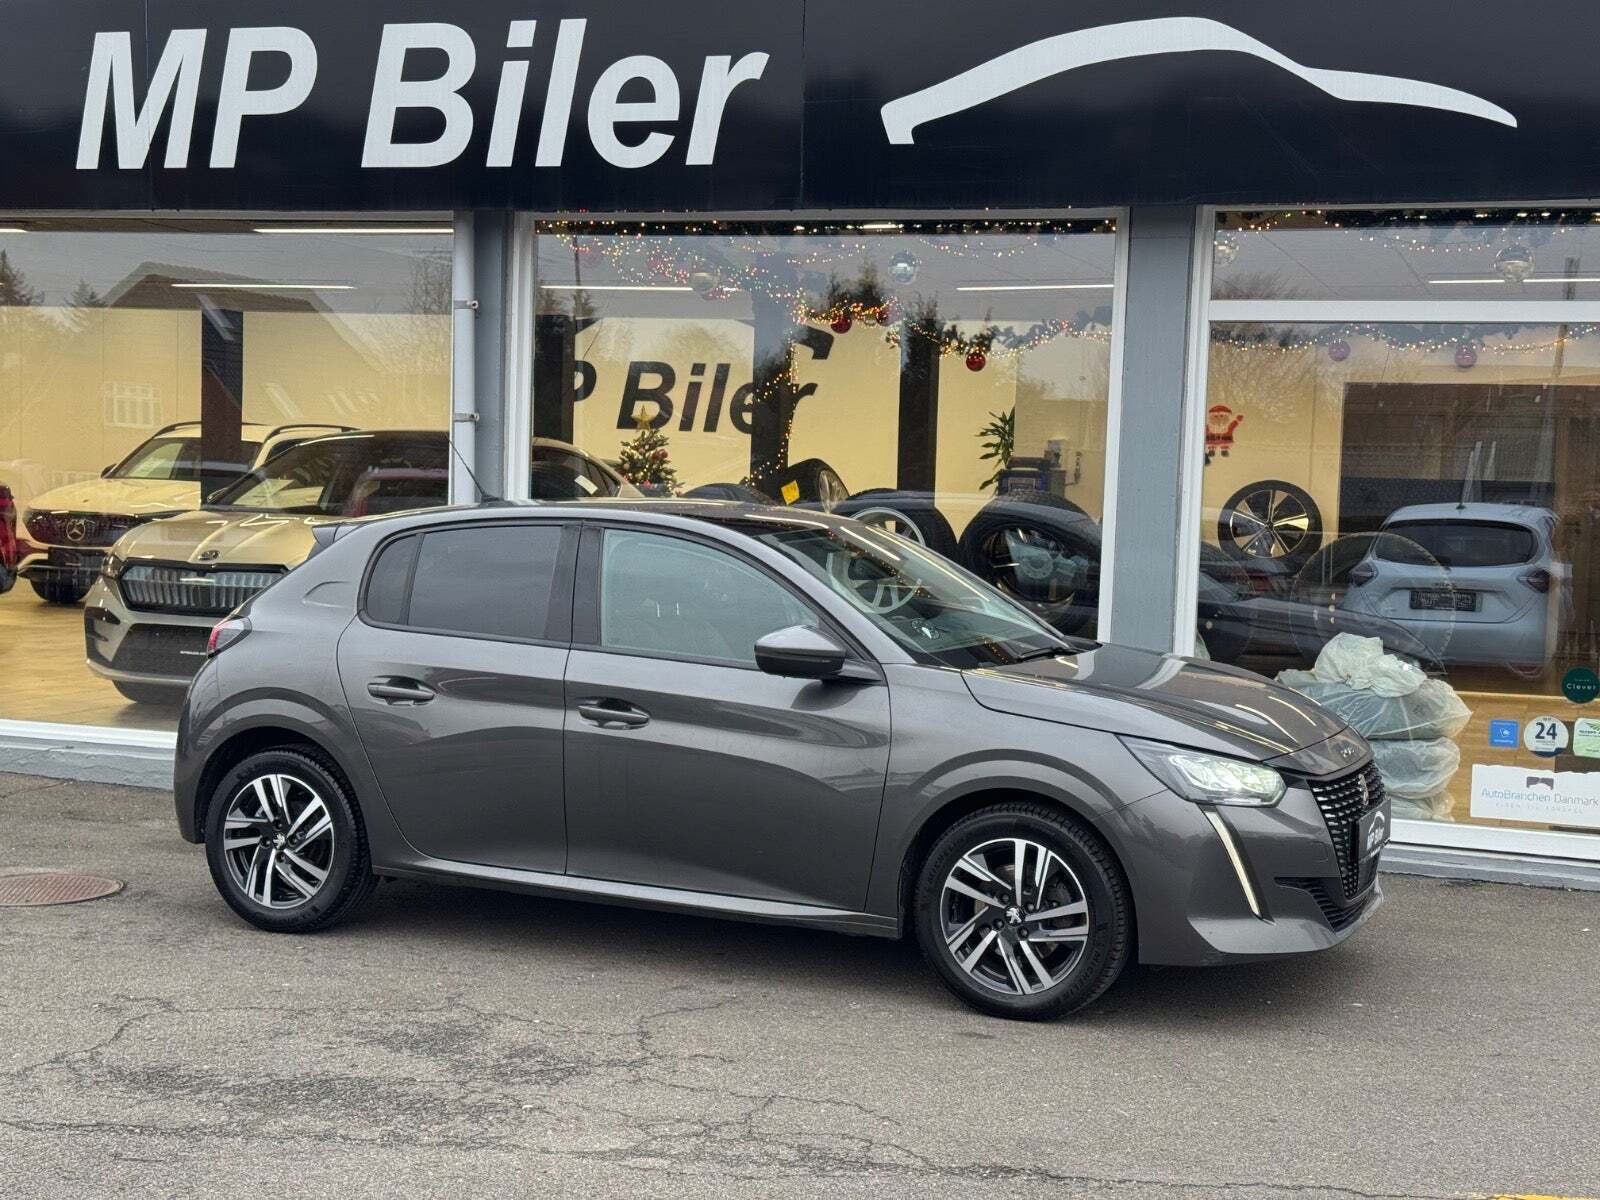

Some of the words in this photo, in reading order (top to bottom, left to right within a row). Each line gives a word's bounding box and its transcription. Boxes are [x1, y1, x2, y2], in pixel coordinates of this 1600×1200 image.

[77, 27, 318, 170] MP
[362, 18, 769, 168] Biler
[1535, 722, 1557, 740] 24
[1482, 788, 1551, 802] AutoBranchen
[1554, 793, 1599, 806] Danmark
